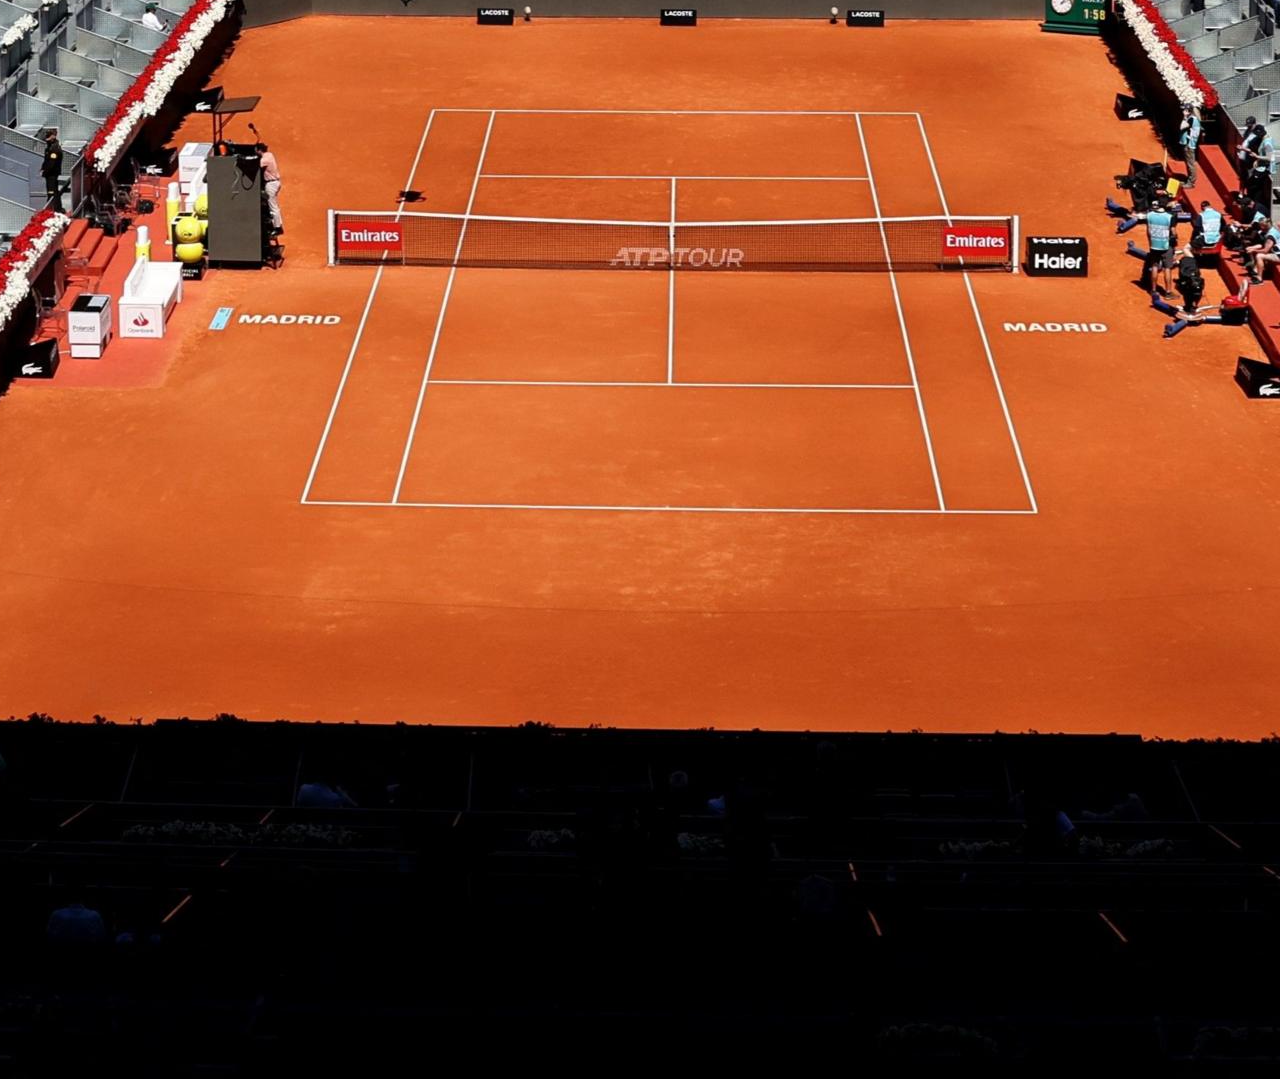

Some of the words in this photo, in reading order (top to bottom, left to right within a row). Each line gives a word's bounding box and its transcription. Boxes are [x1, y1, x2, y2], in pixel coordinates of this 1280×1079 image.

[1083, 9, 1106, 20] 1:58
[341, 229, 399, 242] Emirates
[946, 234, 1006, 248] Emirates
[1032, 237, 1081, 245] Haier
[609, 247, 670, 266] ATP
[672, 247, 745, 267] TOUR
[1034, 253, 1082, 269] Haier
[238, 314, 341, 325] MADRID
[72, 325, 96, 333] Polaroid
[1003, 322, 1108, 332] MADRID
